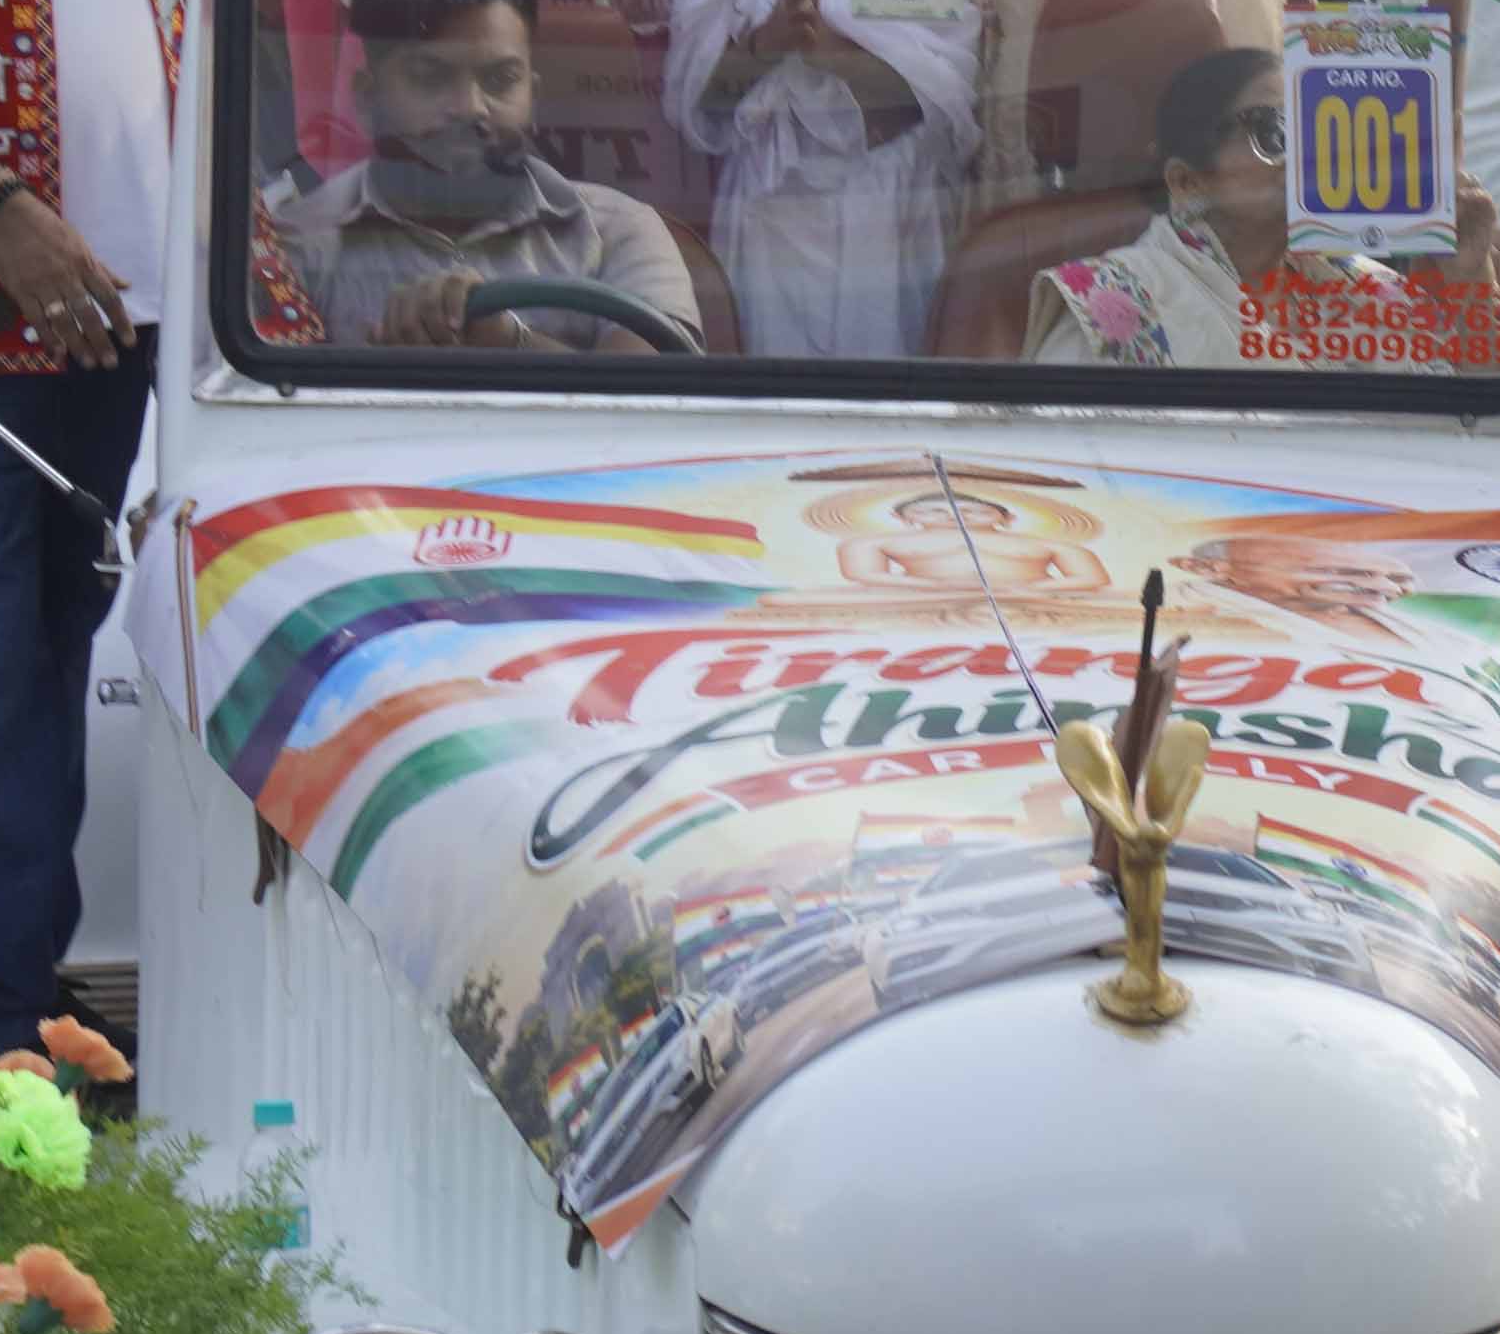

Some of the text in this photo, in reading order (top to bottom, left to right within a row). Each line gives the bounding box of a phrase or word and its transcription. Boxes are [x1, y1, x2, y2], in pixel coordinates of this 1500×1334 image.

[1325, 69, 1405, 89] CAR NO.
[1315, 95, 1423, 211] 001
[488, 628, 1437, 726] Tiranga
[787, 749, 983, 794] CAR
